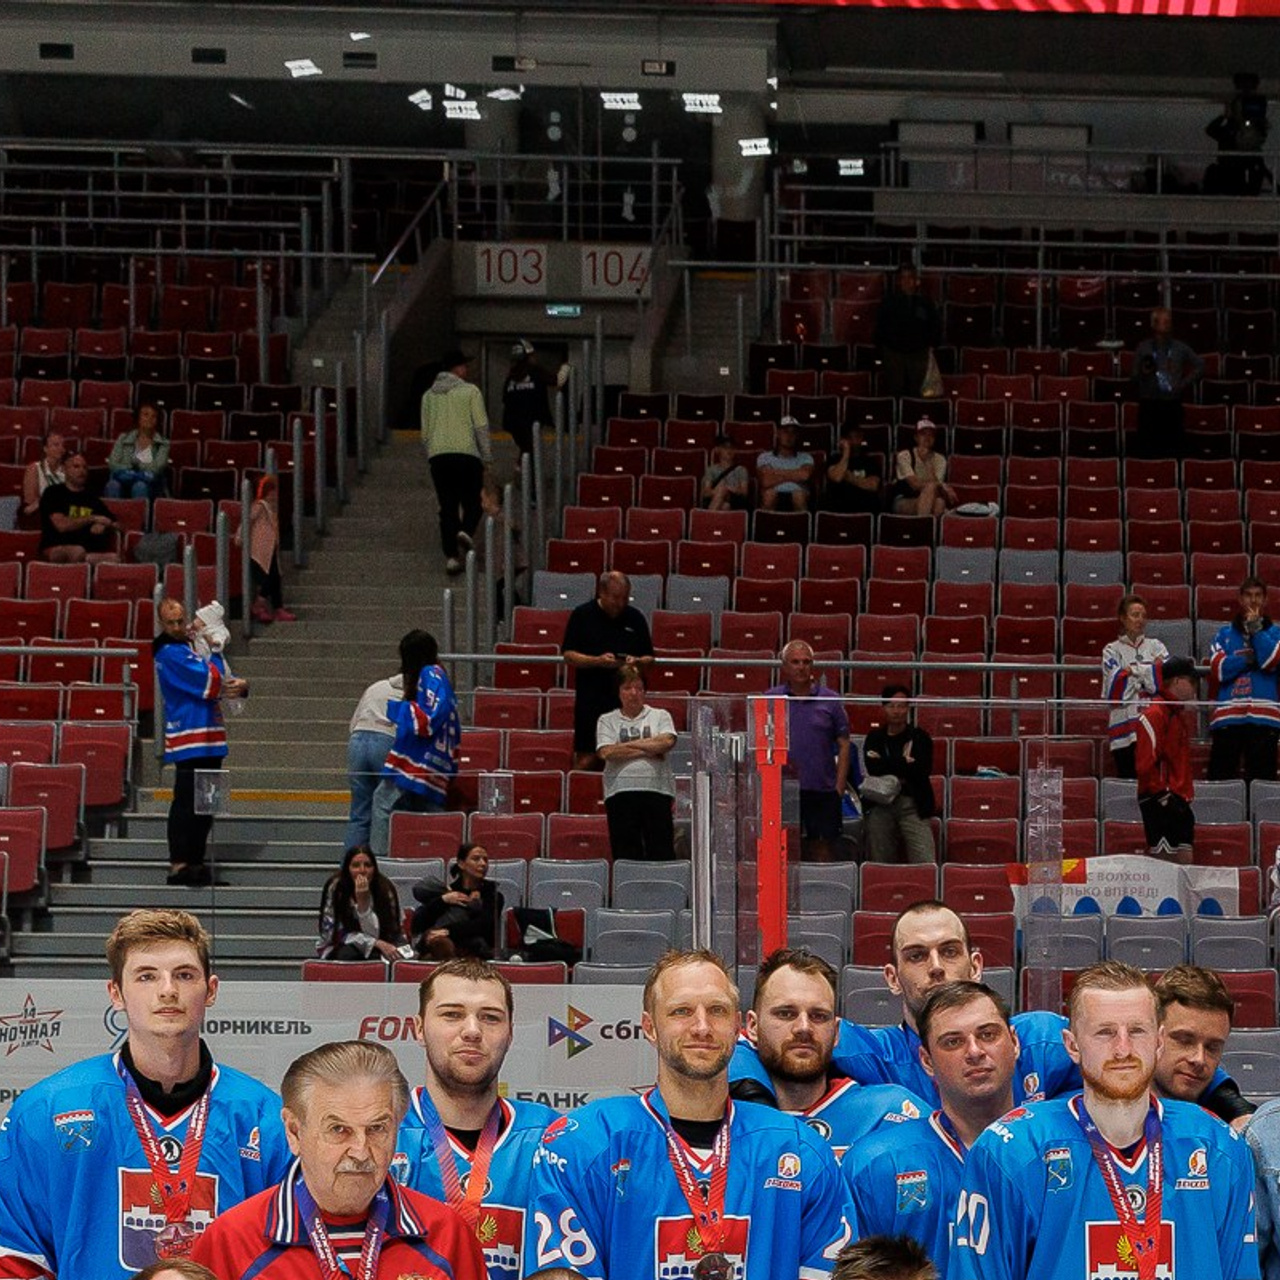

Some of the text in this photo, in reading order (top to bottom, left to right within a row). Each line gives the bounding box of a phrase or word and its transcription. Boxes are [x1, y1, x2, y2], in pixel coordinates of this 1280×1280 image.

[480, 248, 544, 285] 103
[585, 250, 650, 287] 104
[0, 1021, 61, 1043] НОЧНАЯ
[200, 1019, 312, 1035] ОРНИКЕЛЬ
[516, 1091, 589, 1108] БАНК
[534, 1206, 597, 1267] 28
